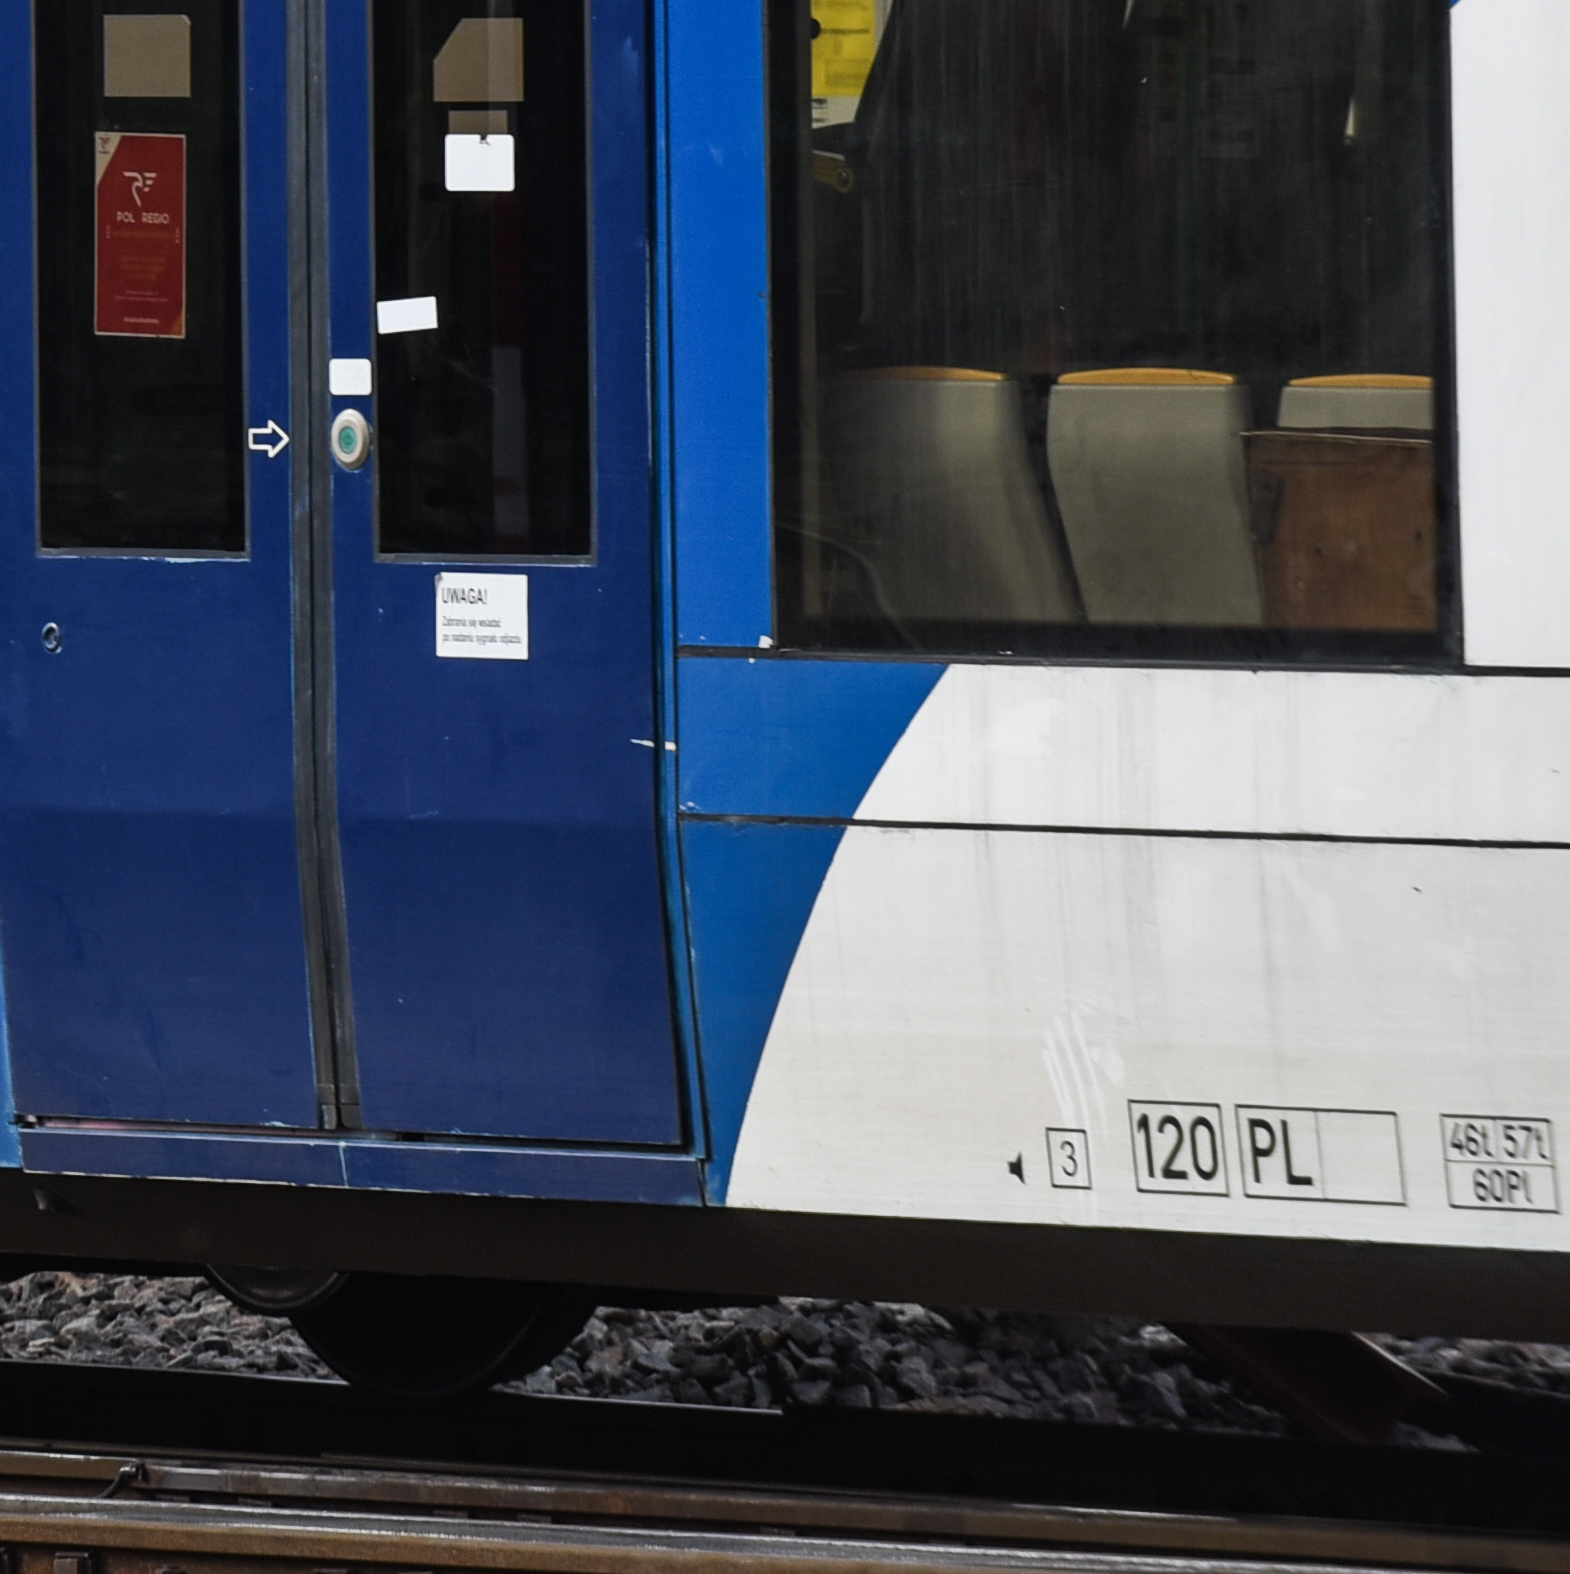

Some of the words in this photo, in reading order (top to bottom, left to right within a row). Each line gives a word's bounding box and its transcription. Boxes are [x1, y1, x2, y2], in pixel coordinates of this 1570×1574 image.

[116, 211, 135, 223] POL
[441, 587, 488, 605] UWAGA!
[1060, 1140, 1079, 1177] 3
[1136, 1112, 1219, 1182] 120
[1248, 1118, 1314, 1187] PL
[1450, 1122, 1494, 1158] 46t
[1502, 1124, 1549, 1160] 57t
